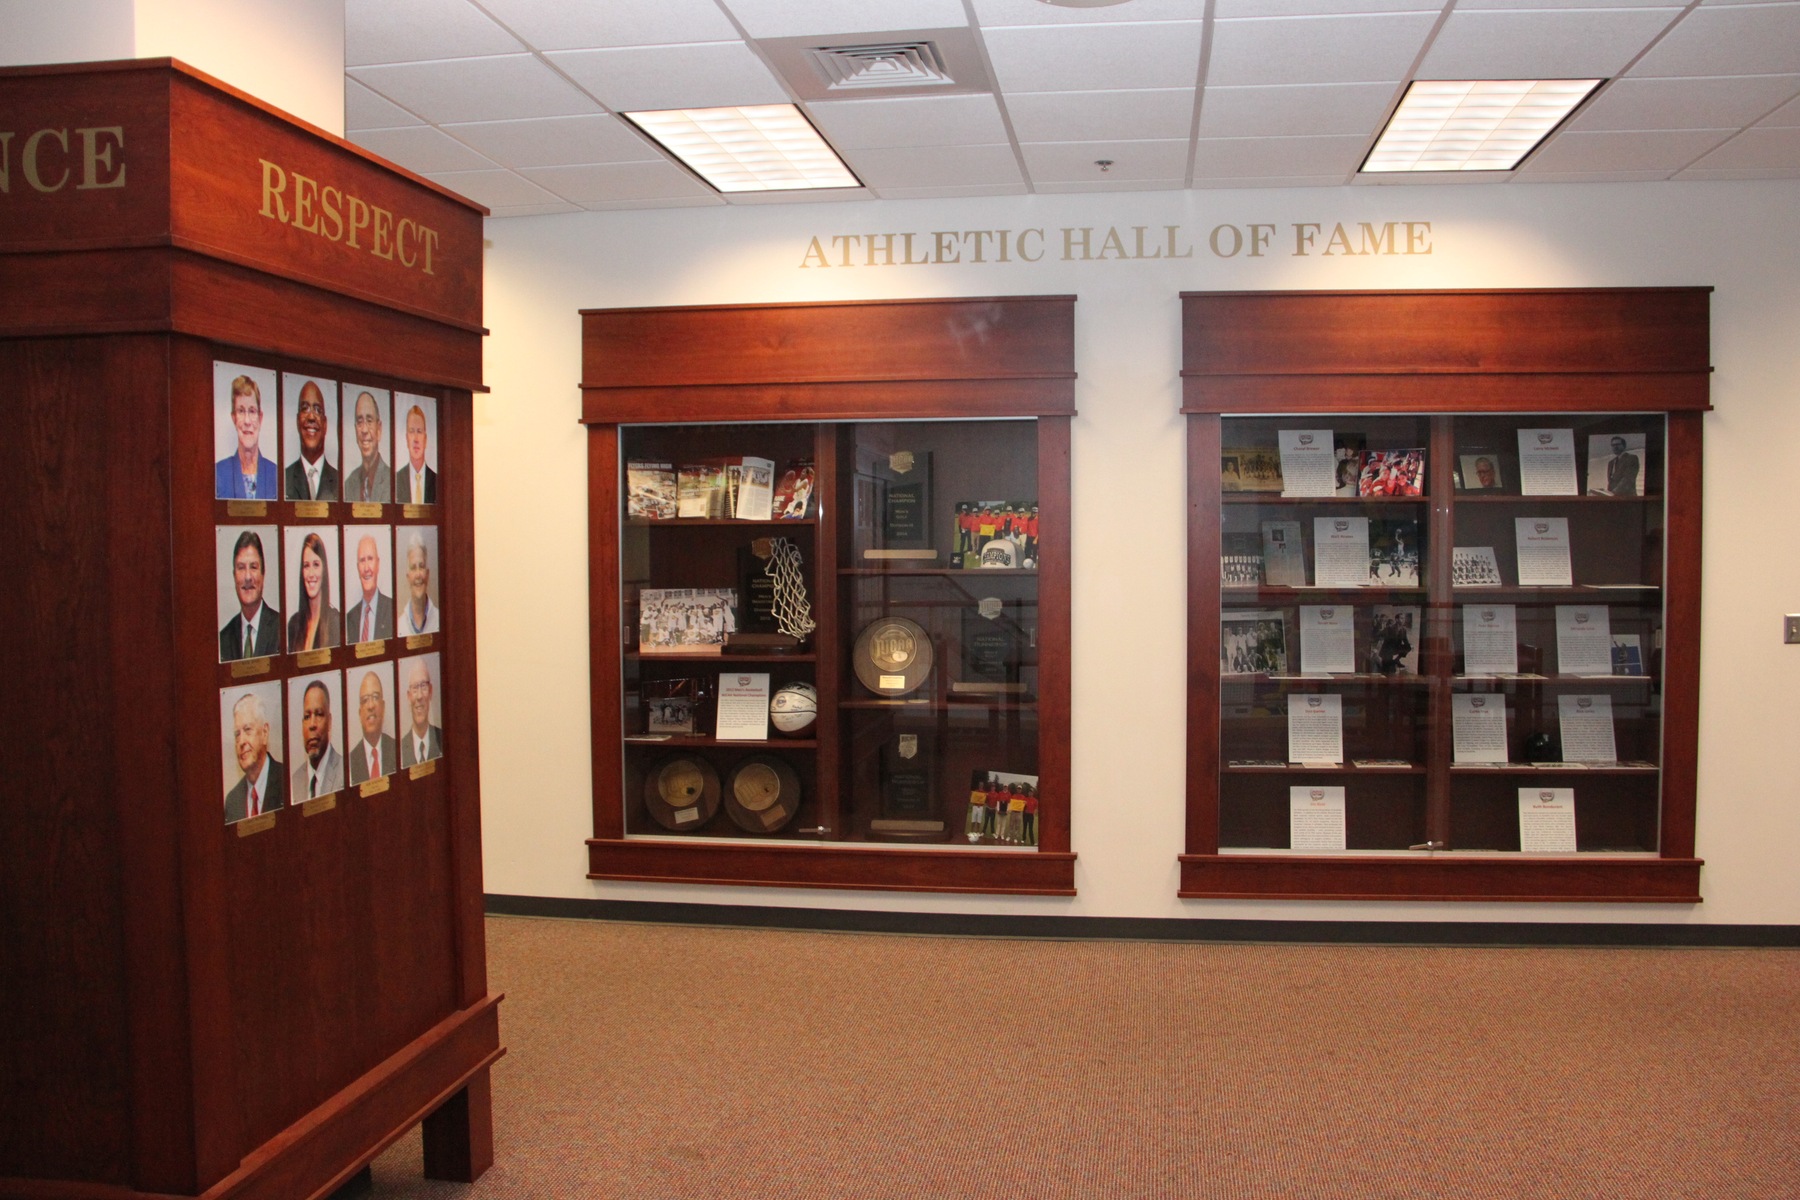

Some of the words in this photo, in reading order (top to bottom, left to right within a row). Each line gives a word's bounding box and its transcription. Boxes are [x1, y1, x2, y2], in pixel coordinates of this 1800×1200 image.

[258, 158, 439, 275] RESPECT
[798, 228, 1045, 268] ATHLETIC
[1060, 225, 1193, 261] HALL
[1209, 223, 1276, 258] OF
[1291, 222, 1432, 256] FAME
